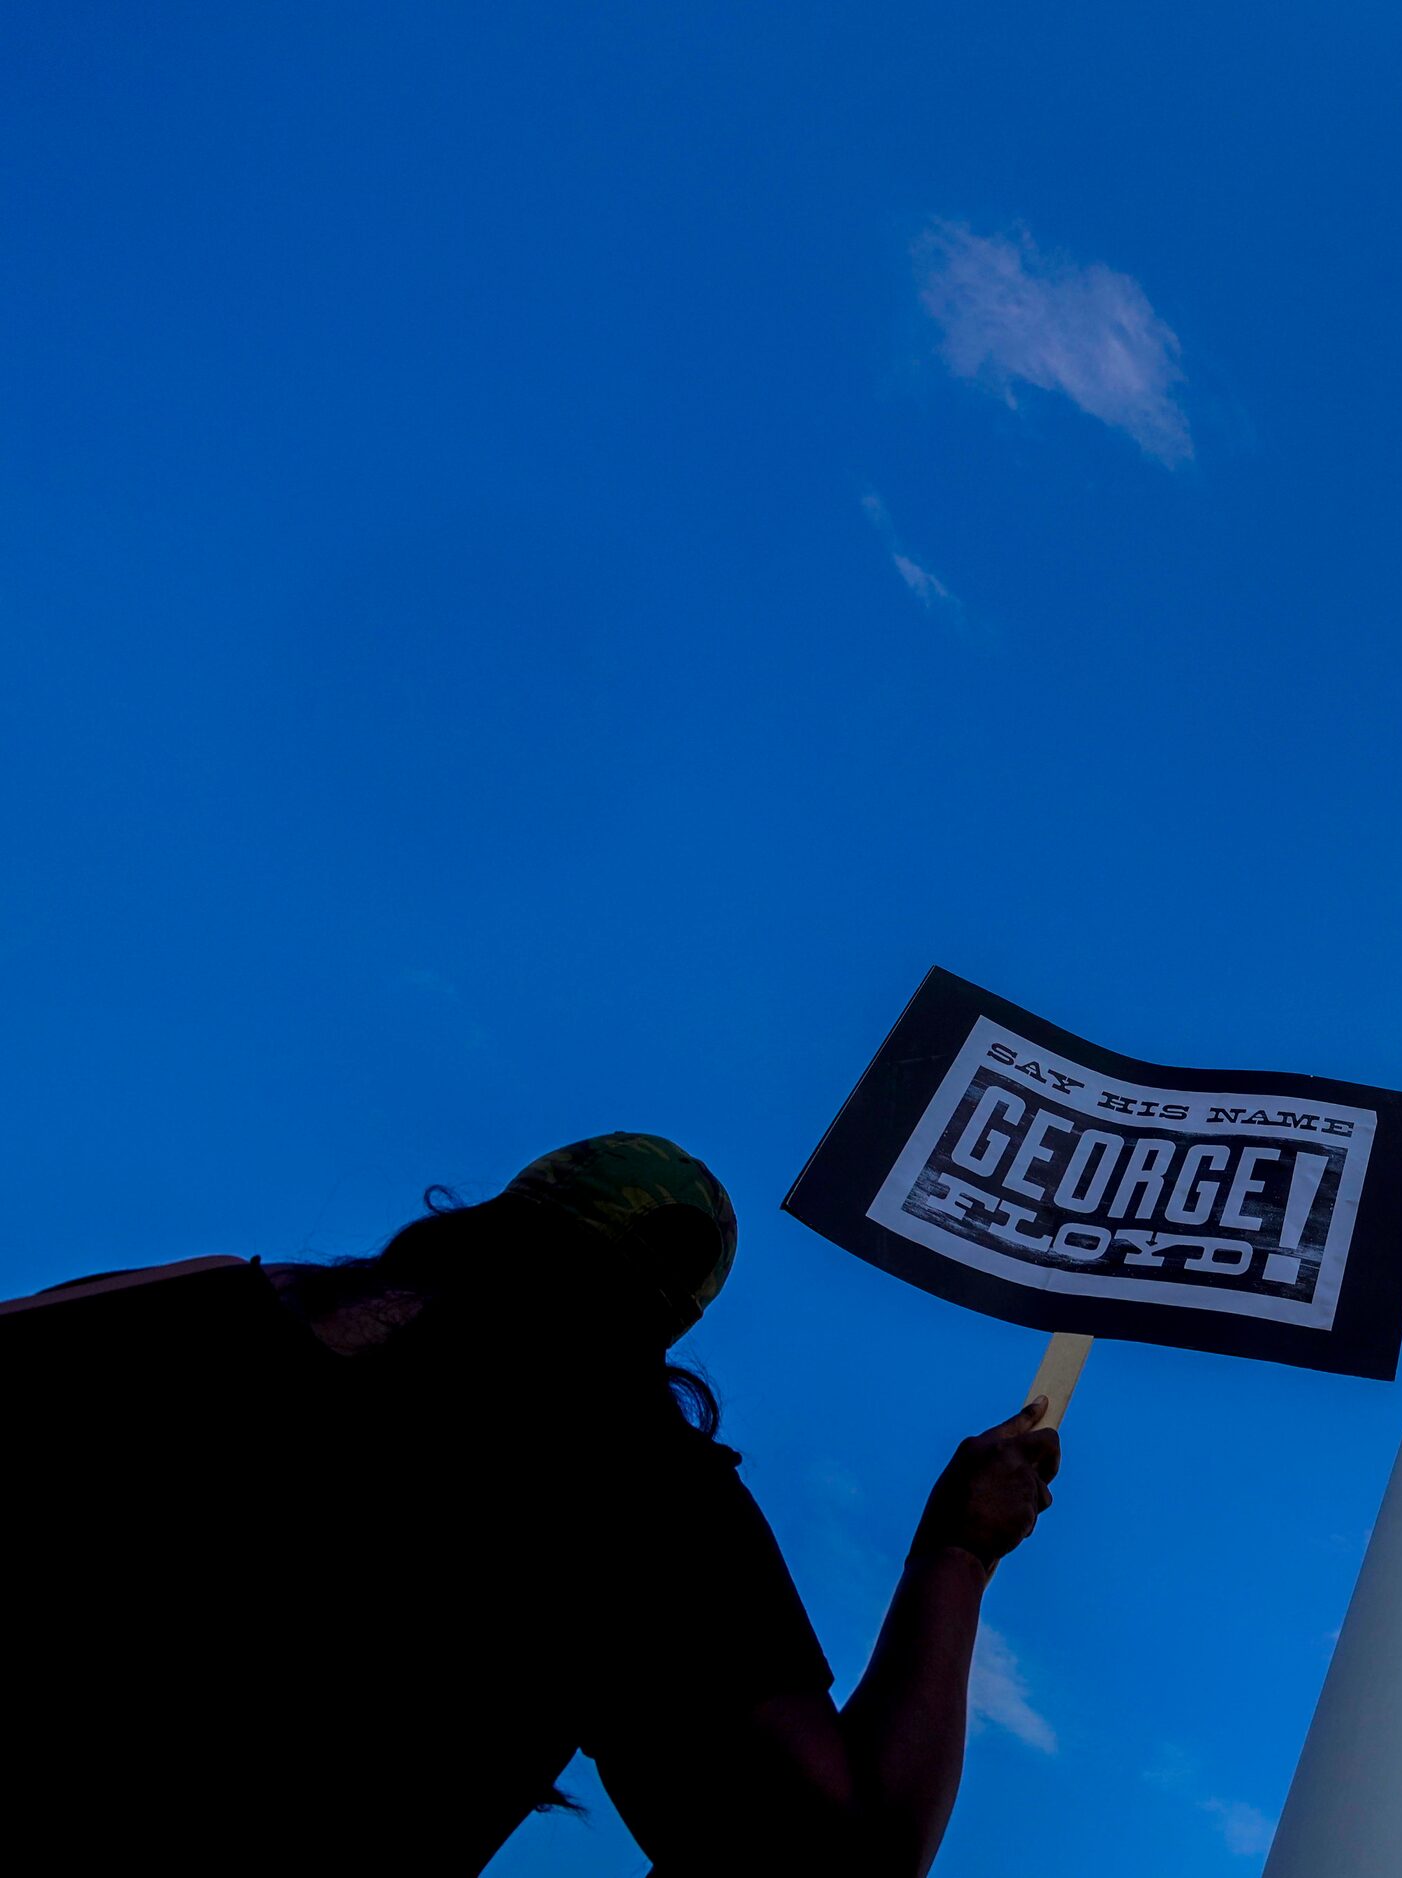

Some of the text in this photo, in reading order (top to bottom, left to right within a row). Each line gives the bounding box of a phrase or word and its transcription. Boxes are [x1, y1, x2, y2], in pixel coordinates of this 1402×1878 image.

[987, 1042, 1354, 1137] SAY HIS NAME
